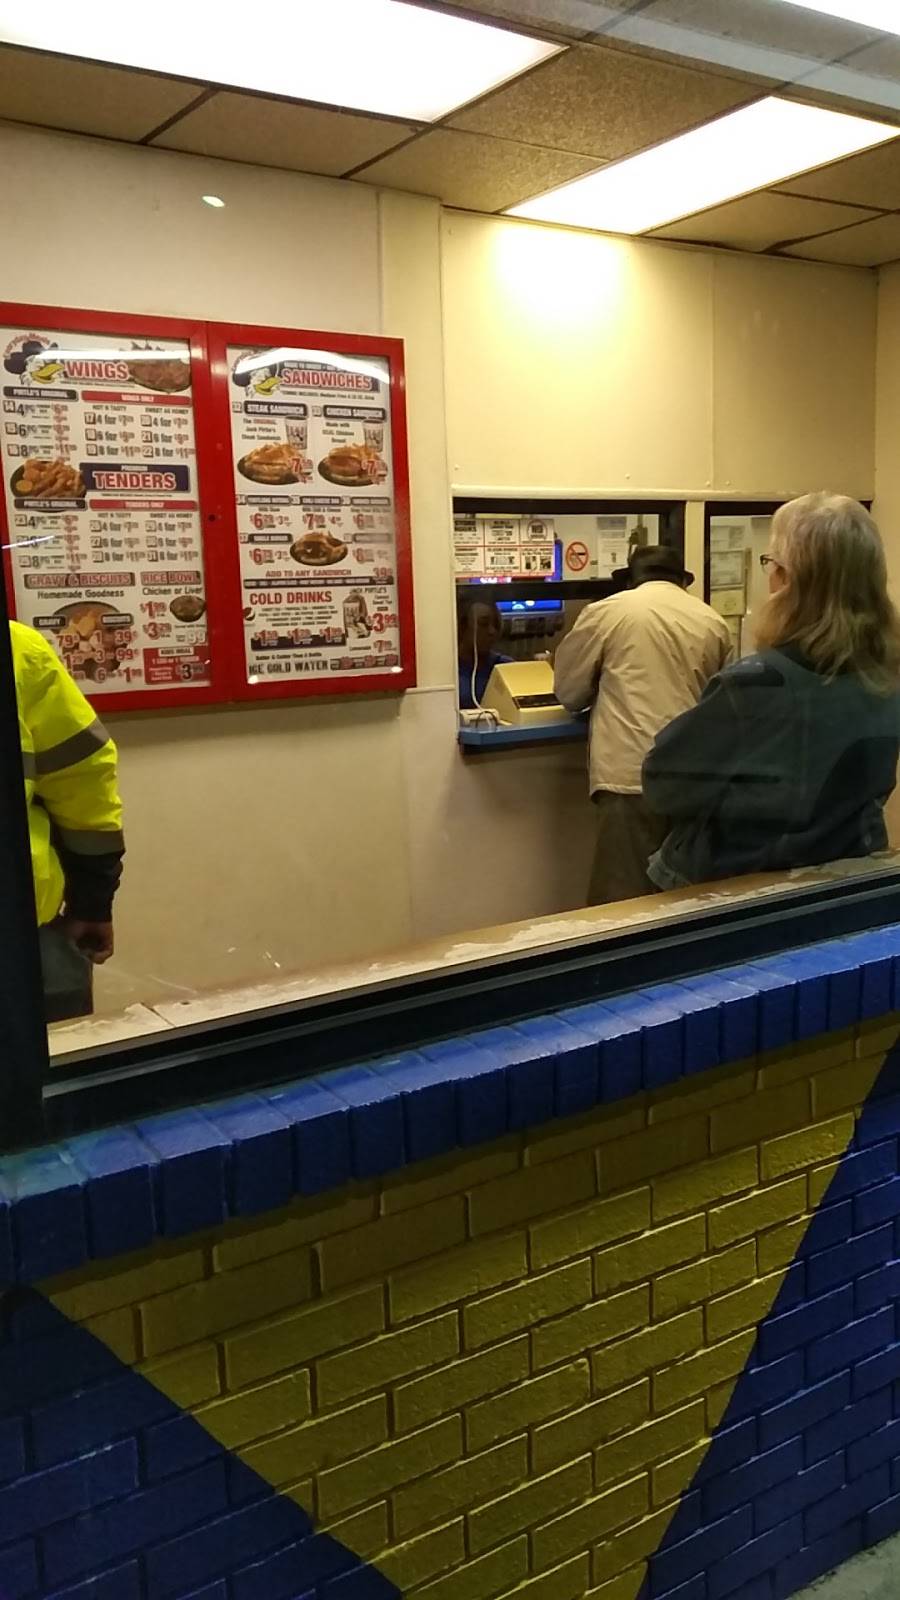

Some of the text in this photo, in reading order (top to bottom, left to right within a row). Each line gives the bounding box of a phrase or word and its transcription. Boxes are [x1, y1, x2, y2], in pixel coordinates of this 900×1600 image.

[66, 360, 130, 380] WINGS
[282, 369, 372, 390] SANDWICHES
[92, 471, 176, 490] TENDERS
[80, 574, 130, 585] BISCUITS
[37, 589, 125, 600] Homemade Goodness
[142, 587, 172, 596] Chicken
[185, 585, 203, 594] Liver
[250, 591, 332, 605] COLD DRINKS
[294, 660, 328, 671] WATER
